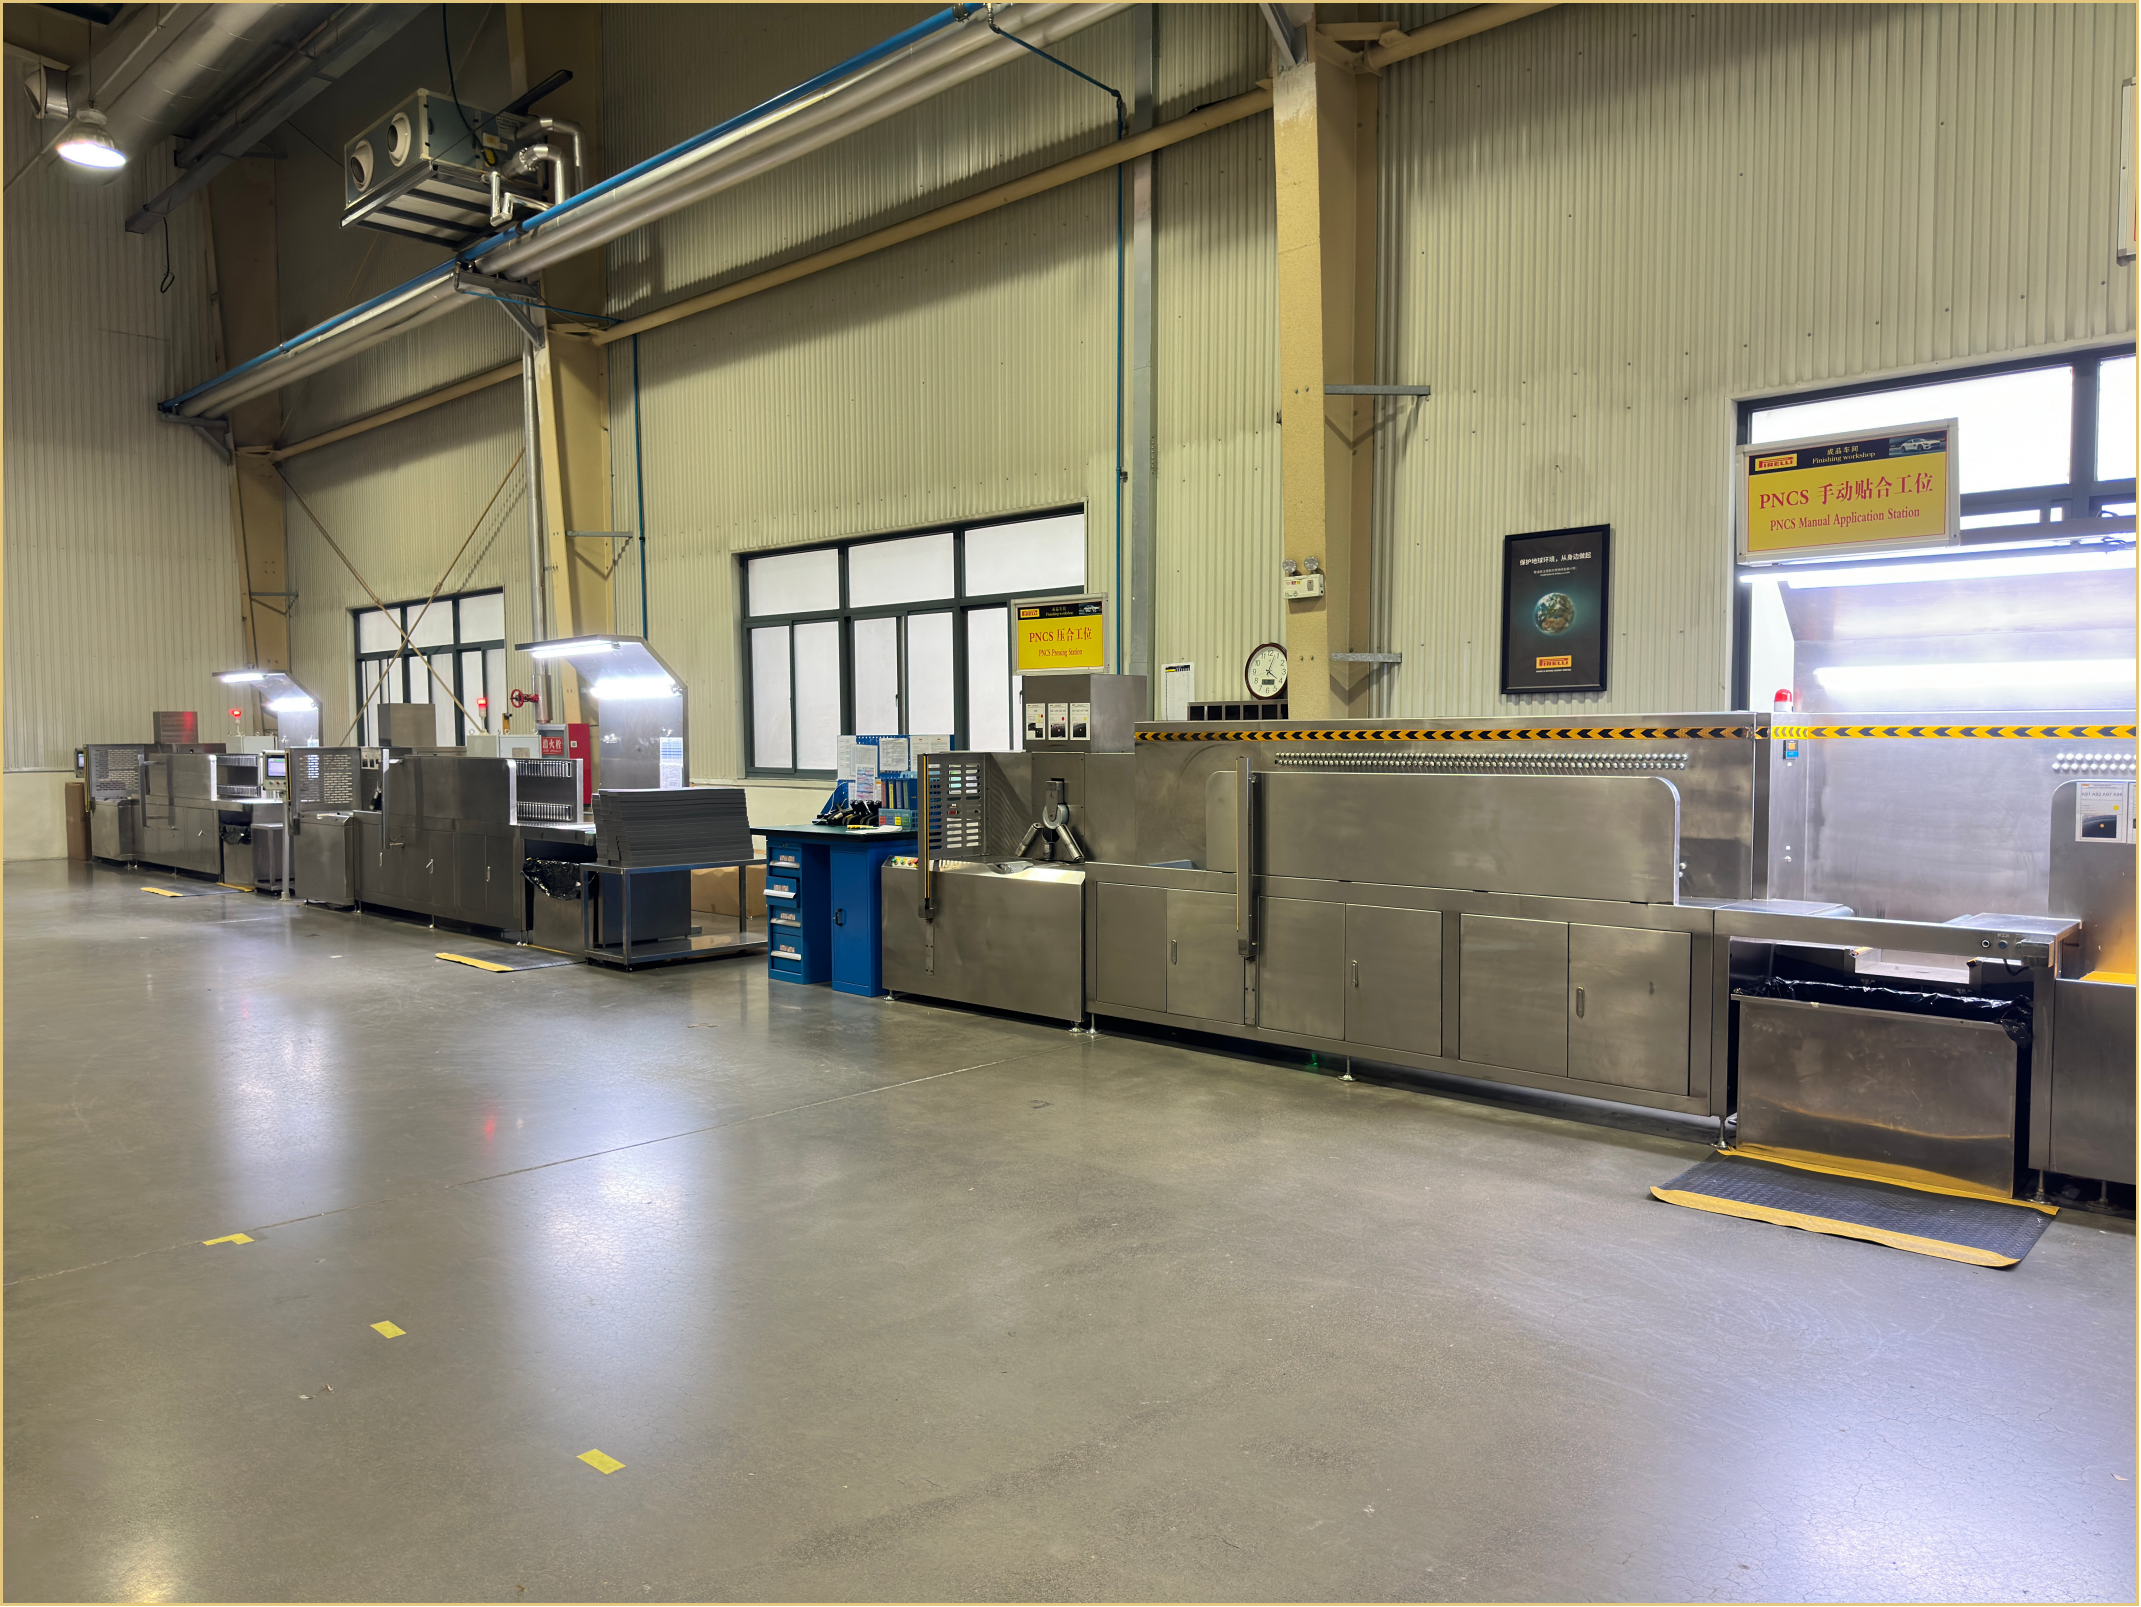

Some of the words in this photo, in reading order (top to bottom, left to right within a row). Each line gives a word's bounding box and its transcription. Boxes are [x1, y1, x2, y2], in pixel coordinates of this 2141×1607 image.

[1758, 457, 1794, 469] PIRELLI
[1812, 455, 1842, 465] Finishing
[1842, 452, 1876, 461] workshop
[1759, 489, 1809, 509] PNCS
[1816, 472, 1933, 505] 手动贴合工位
[1770, 518, 1796, 531] PNCS
[1799, 514, 1830, 528] Manual
[1833, 509, 1884, 527] Application
[1887, 506, 1920, 520] Station
[1029, 631, 1054, 642] PNCS
[1057, 627, 1092, 641] 压合工位
[1038, 649, 1051, 657] PNCS
[1068, 647, 1082, 656] Station
[1539, 657, 1569, 667] PIRELLI
